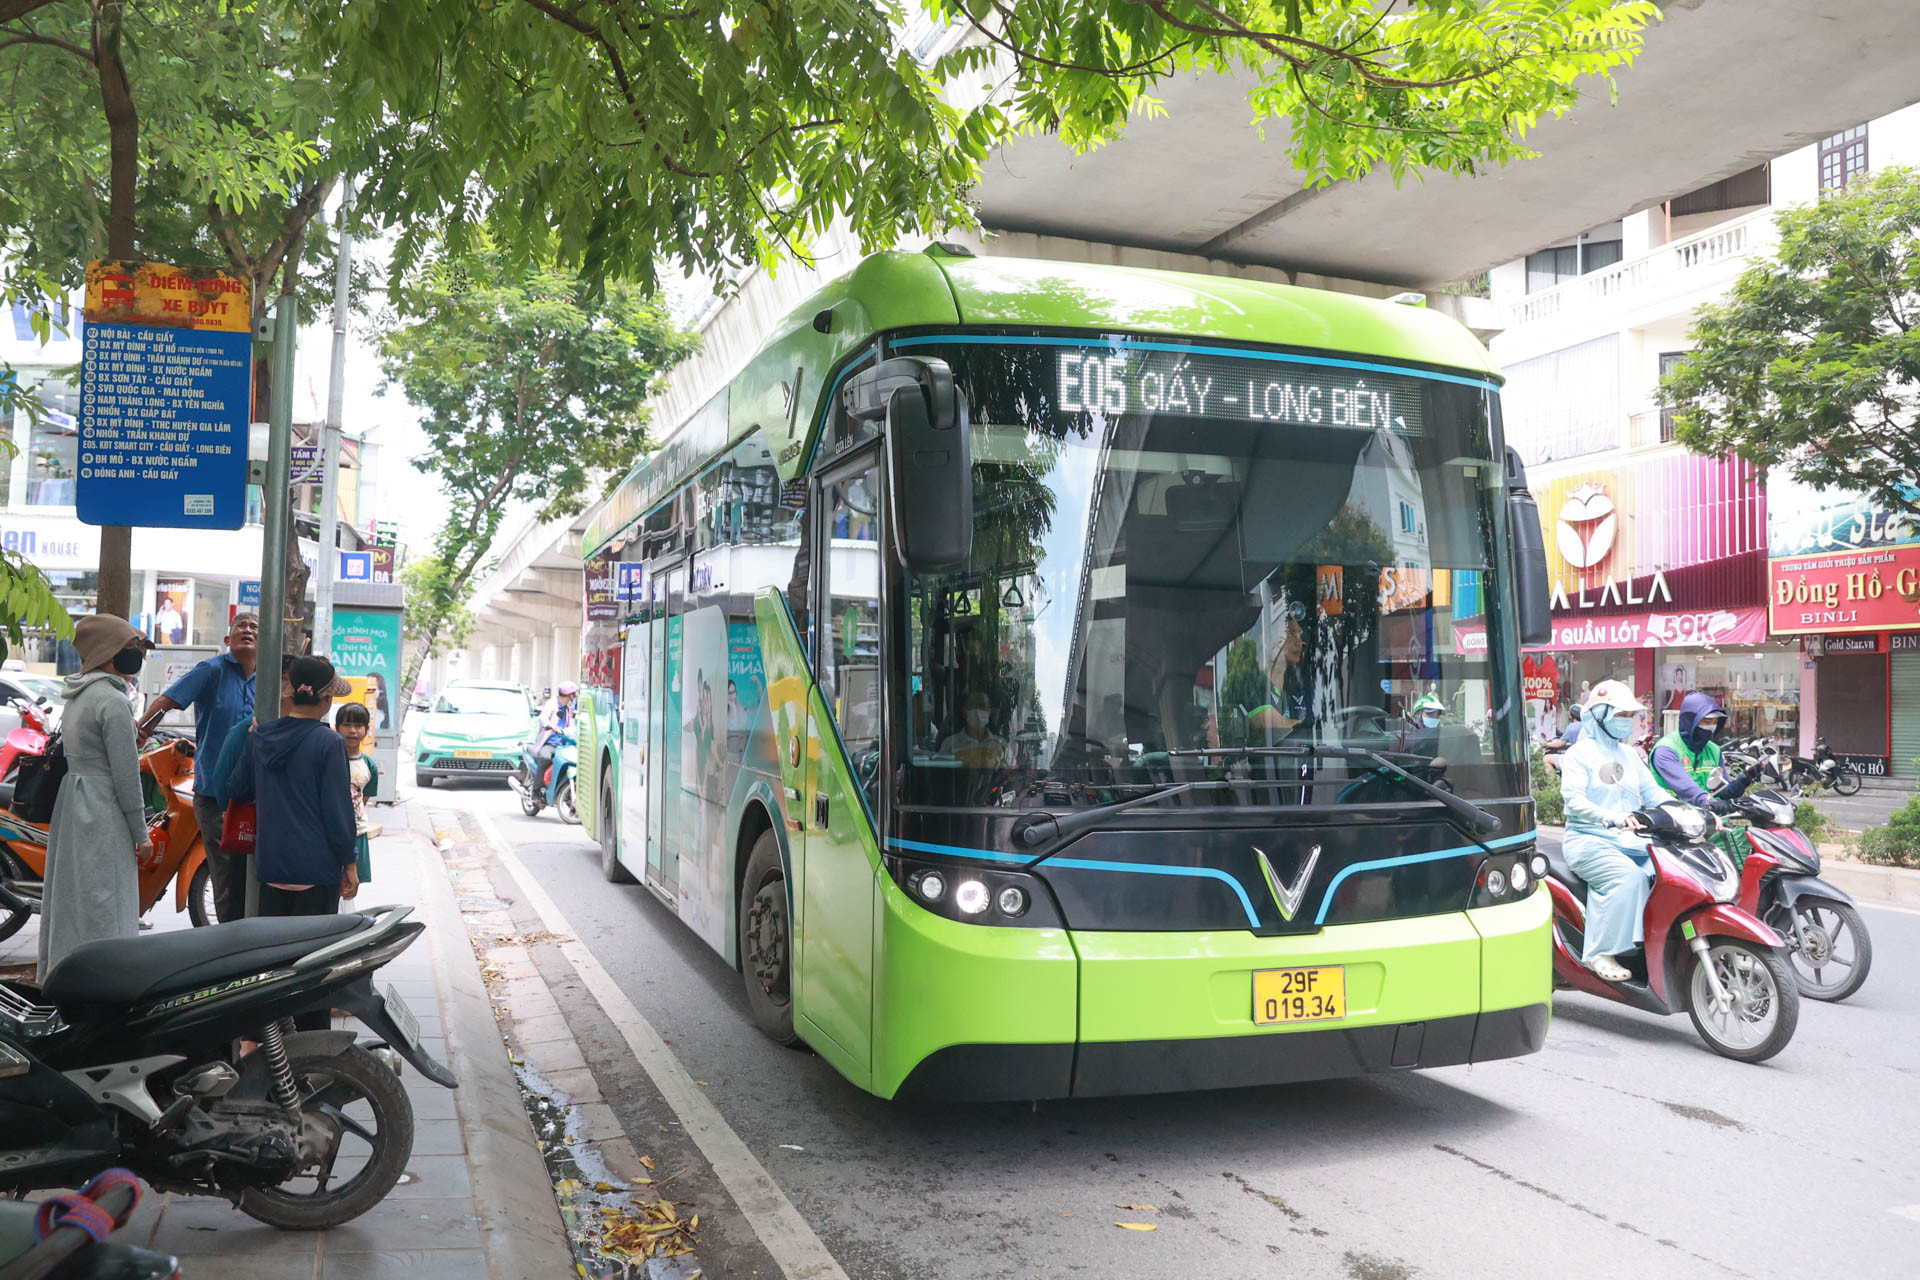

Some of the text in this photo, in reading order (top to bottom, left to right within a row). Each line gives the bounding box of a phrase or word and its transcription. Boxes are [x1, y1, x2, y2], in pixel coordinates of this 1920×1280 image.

[162, 299, 182, 312] XE
[100, 328, 114, 340] NỘI
[116, 328, 130, 340] BÀI
[156, 331, 174, 342] GIẤY
[100, 340, 110, 350] BX
[112, 340, 125, 350] MỸ
[100, 352, 110, 360] BX
[111, 351, 122, 361] MỸ
[167, 354, 190, 365] KHÁNH
[98, 362, 110, 371] BX
[112, 362, 124, 372] MỸ
[152, 365, 164, 374] BX
[166, 364, 187, 376] NƯỚC
[98, 374, 110, 382] BX
[112, 374, 130, 383] SƠN
[132, 374, 147, 384] TÂY
[174, 376, 193, 387] GIẤY
[116, 383, 139, 394] QUỐC
[142, 386, 156, 396] GIA
[163, 388, 180, 397] MAI
[182, 388, 204, 398] ĐỘNG
[1058, 354, 1126, 415] E05
[1140, 359, 1213, 414] GIẤY
[1249, 379, 1322, 423] LONG
[1332, 379, 1391, 429] BIÊN
[98, 395, 116, 404] NAM
[145, 398, 165, 407] LONG
[172, 400, 182, 408] BX
[185, 399, 200, 409] YÊN
[202, 400, 224, 410] NGHĨA
[128, 408, 138, 417] BX
[140, 408, 160, 418] GIÁP
[162, 409, 176, 418] BÁT
[96, 418, 108, 427] BX
[110, 417, 122, 428] MỸ
[152, 420, 170, 430] TTHC
[172, 420, 198, 430] HUYỆN
[200, 422, 212, 432] GIA
[214, 422, 231, 432] LÂM
[114, 441, 138, 450] SMART
[139, 442, 154, 451] CITY
[175, 442, 190, 452] GIẤY
[196, 444, 214, 454] LONG
[216, 444, 232, 454] BIÊN
[110, 452, 124, 465] MỎ
[132, 456, 144, 465] BX
[146, 454, 169, 466] NƯỚC
[118, 469, 136, 478] ANH
[160, 468, 178, 480] GIẤY
[42, 542, 79, 557] HOUSE
[1781, 551, 1896, 572] TRUNG TÂM GIỚI THIỆU SẢN PHẨM
[1776, 573, 1839, 609] Đồng
[1896, 567, 1920, 597] G
[1800, 610, 1858, 625] BINLI
[1561, 619, 1606, 645] QUẦN
[1611, 619, 1641, 643] LÓT
[1663, 614, 1716, 643] 59K
[1824, 638, 1875, 650] Gold Star.vn
[1892, 636, 1920, 650] BIN
[330, 651, 387, 668] ANNA
[1280, 970, 1319, 995] 29F
[1265, 994, 1336, 1020] 019.34
